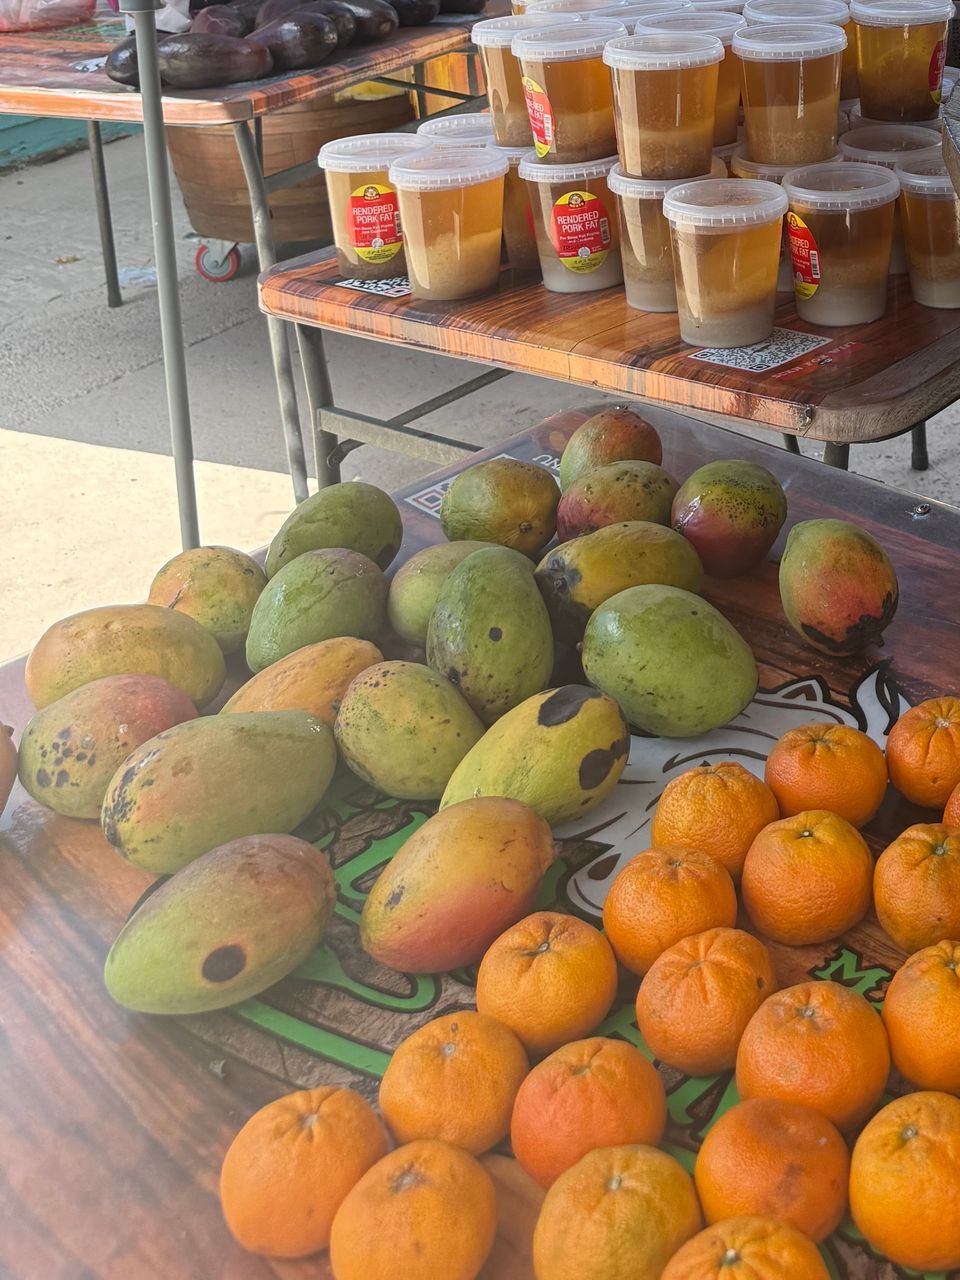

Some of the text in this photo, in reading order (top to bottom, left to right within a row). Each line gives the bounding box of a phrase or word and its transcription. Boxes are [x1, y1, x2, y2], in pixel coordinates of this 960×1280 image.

[352, 204, 394, 215] RENDERED
[356, 212, 393, 224] PORK FAT
[557, 211, 599, 225] RENDERED
[562, 220, 599, 233] PORK FAT
[799, 248, 809, 257] FAT
